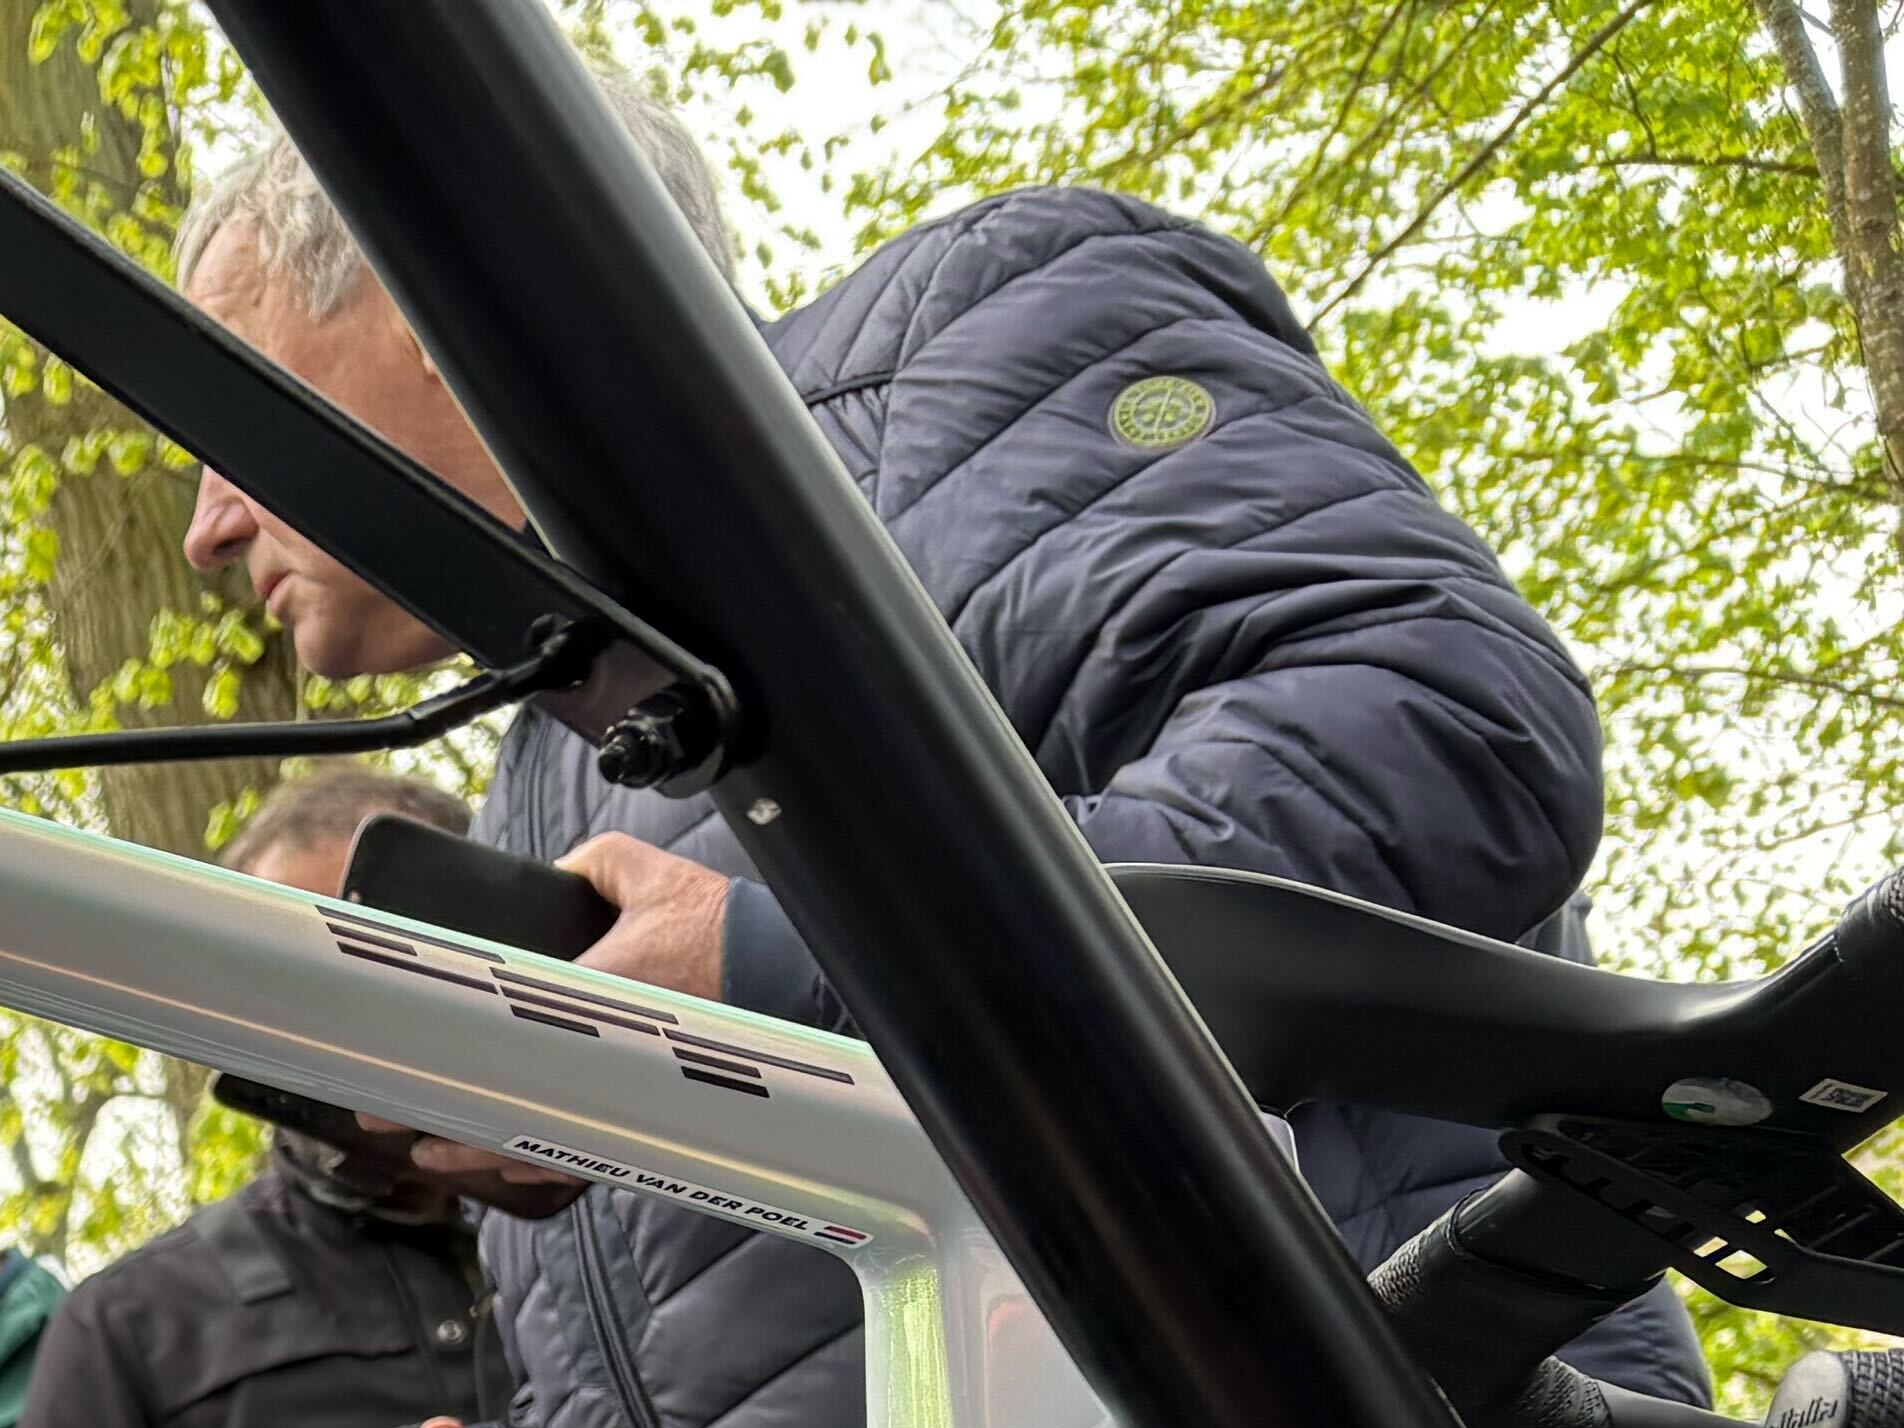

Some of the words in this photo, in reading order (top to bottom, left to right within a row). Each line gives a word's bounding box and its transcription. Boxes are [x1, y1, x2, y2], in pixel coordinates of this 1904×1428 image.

[513, 1139, 631, 1179] MATHIEU
[636, 1172, 688, 1195] VAN
[688, 1189, 745, 1212] DER
[744, 1206, 811, 1232] POEL
